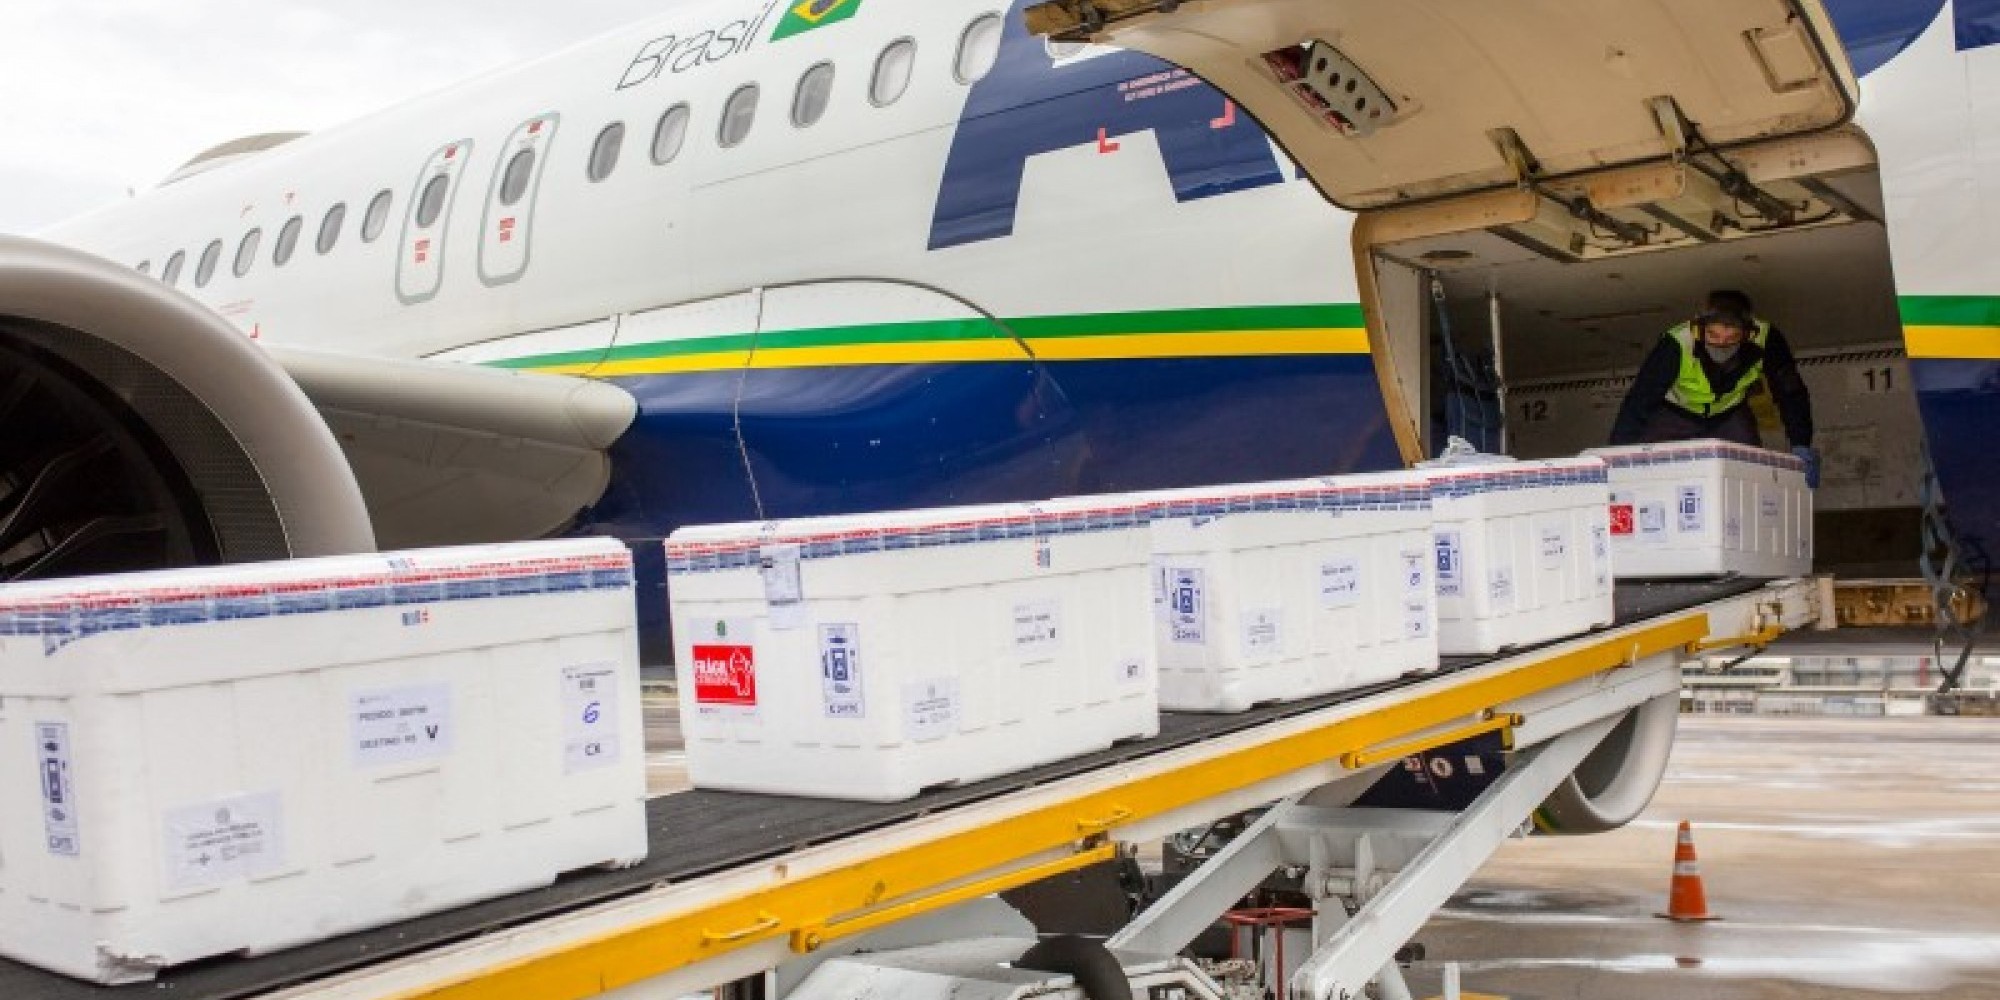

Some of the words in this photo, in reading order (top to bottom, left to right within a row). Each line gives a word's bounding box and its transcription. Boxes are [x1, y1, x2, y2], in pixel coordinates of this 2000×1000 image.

[615, 0, 778, 91] Brasil
[1862, 367, 1892, 391] 11
[1520, 401, 1548, 421] 12
[583, 702, 600, 723] 6
[424, 724, 438, 740] V
